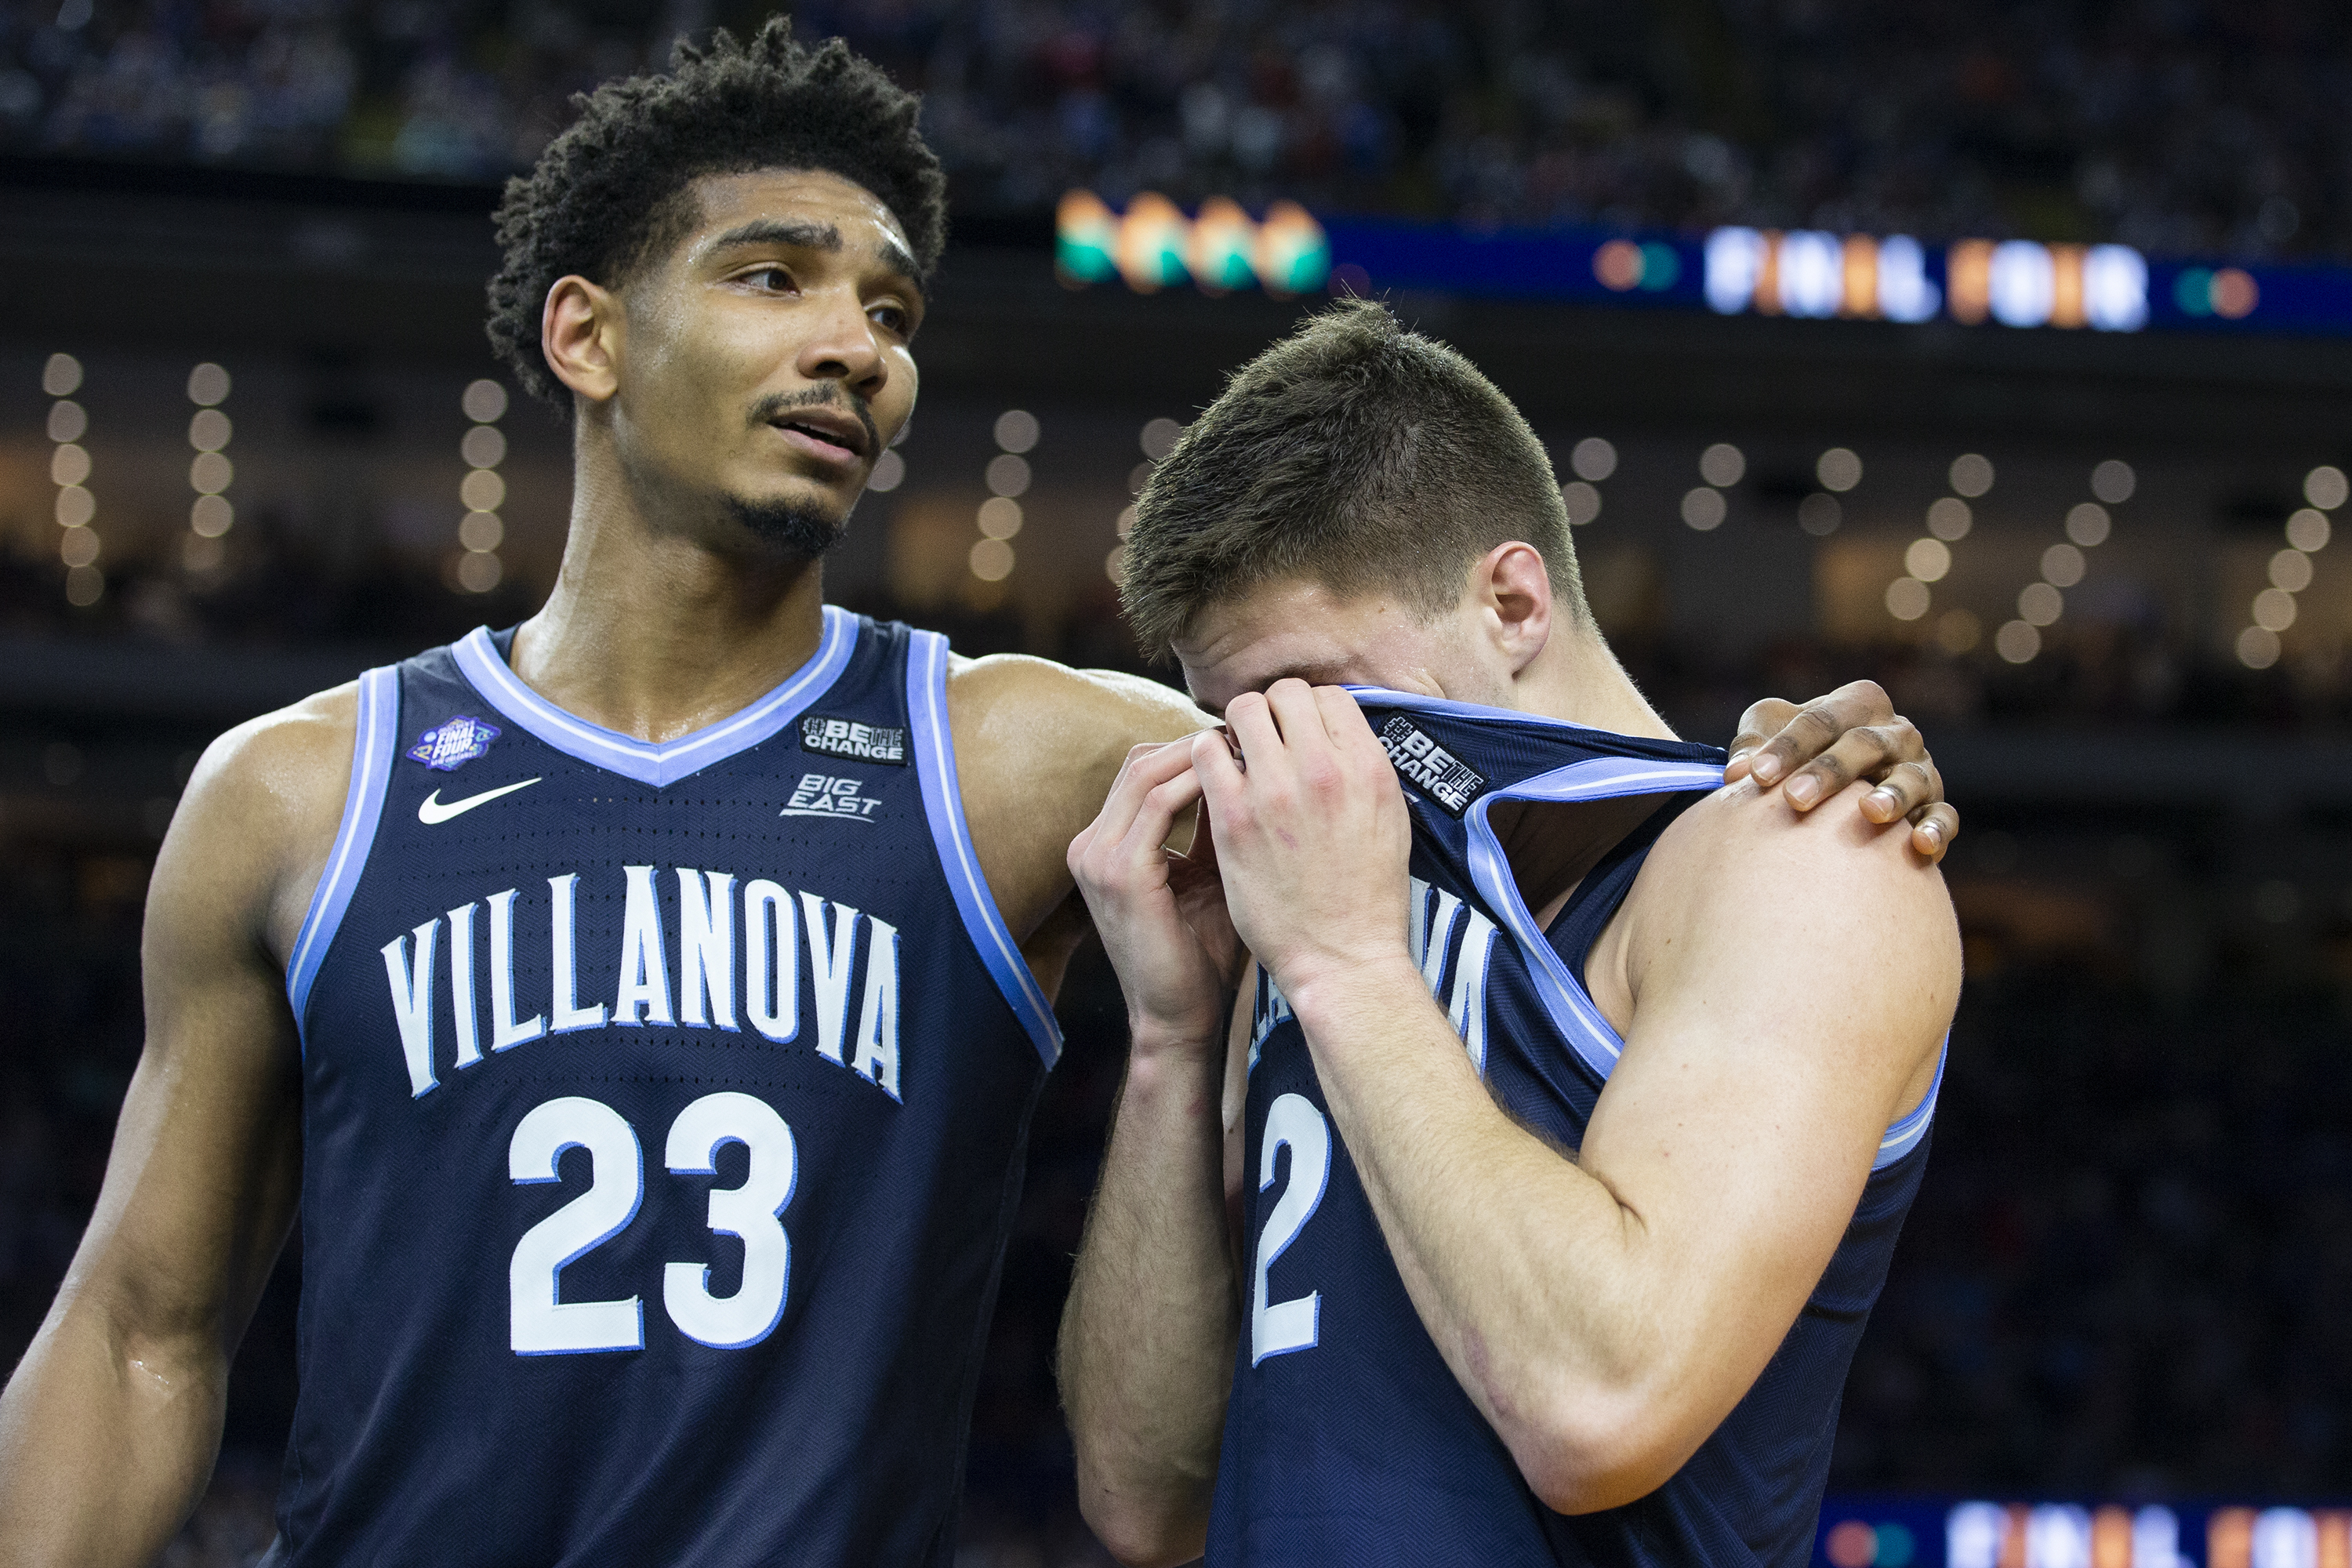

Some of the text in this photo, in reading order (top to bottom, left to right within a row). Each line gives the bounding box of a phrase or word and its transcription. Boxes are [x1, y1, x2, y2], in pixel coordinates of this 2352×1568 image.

[437, 725, 475, 746] FINAL
[804, 735, 904, 760] CHANGE
[432, 738, 473, 759] FOUR
[797, 774, 862, 796] BIG
[787, 790, 882, 815] EAST
[381, 865, 902, 1102] VILLANOVA
[509, 1091, 797, 1356] 23
[1252, 1093, 1333, 1368] 2
